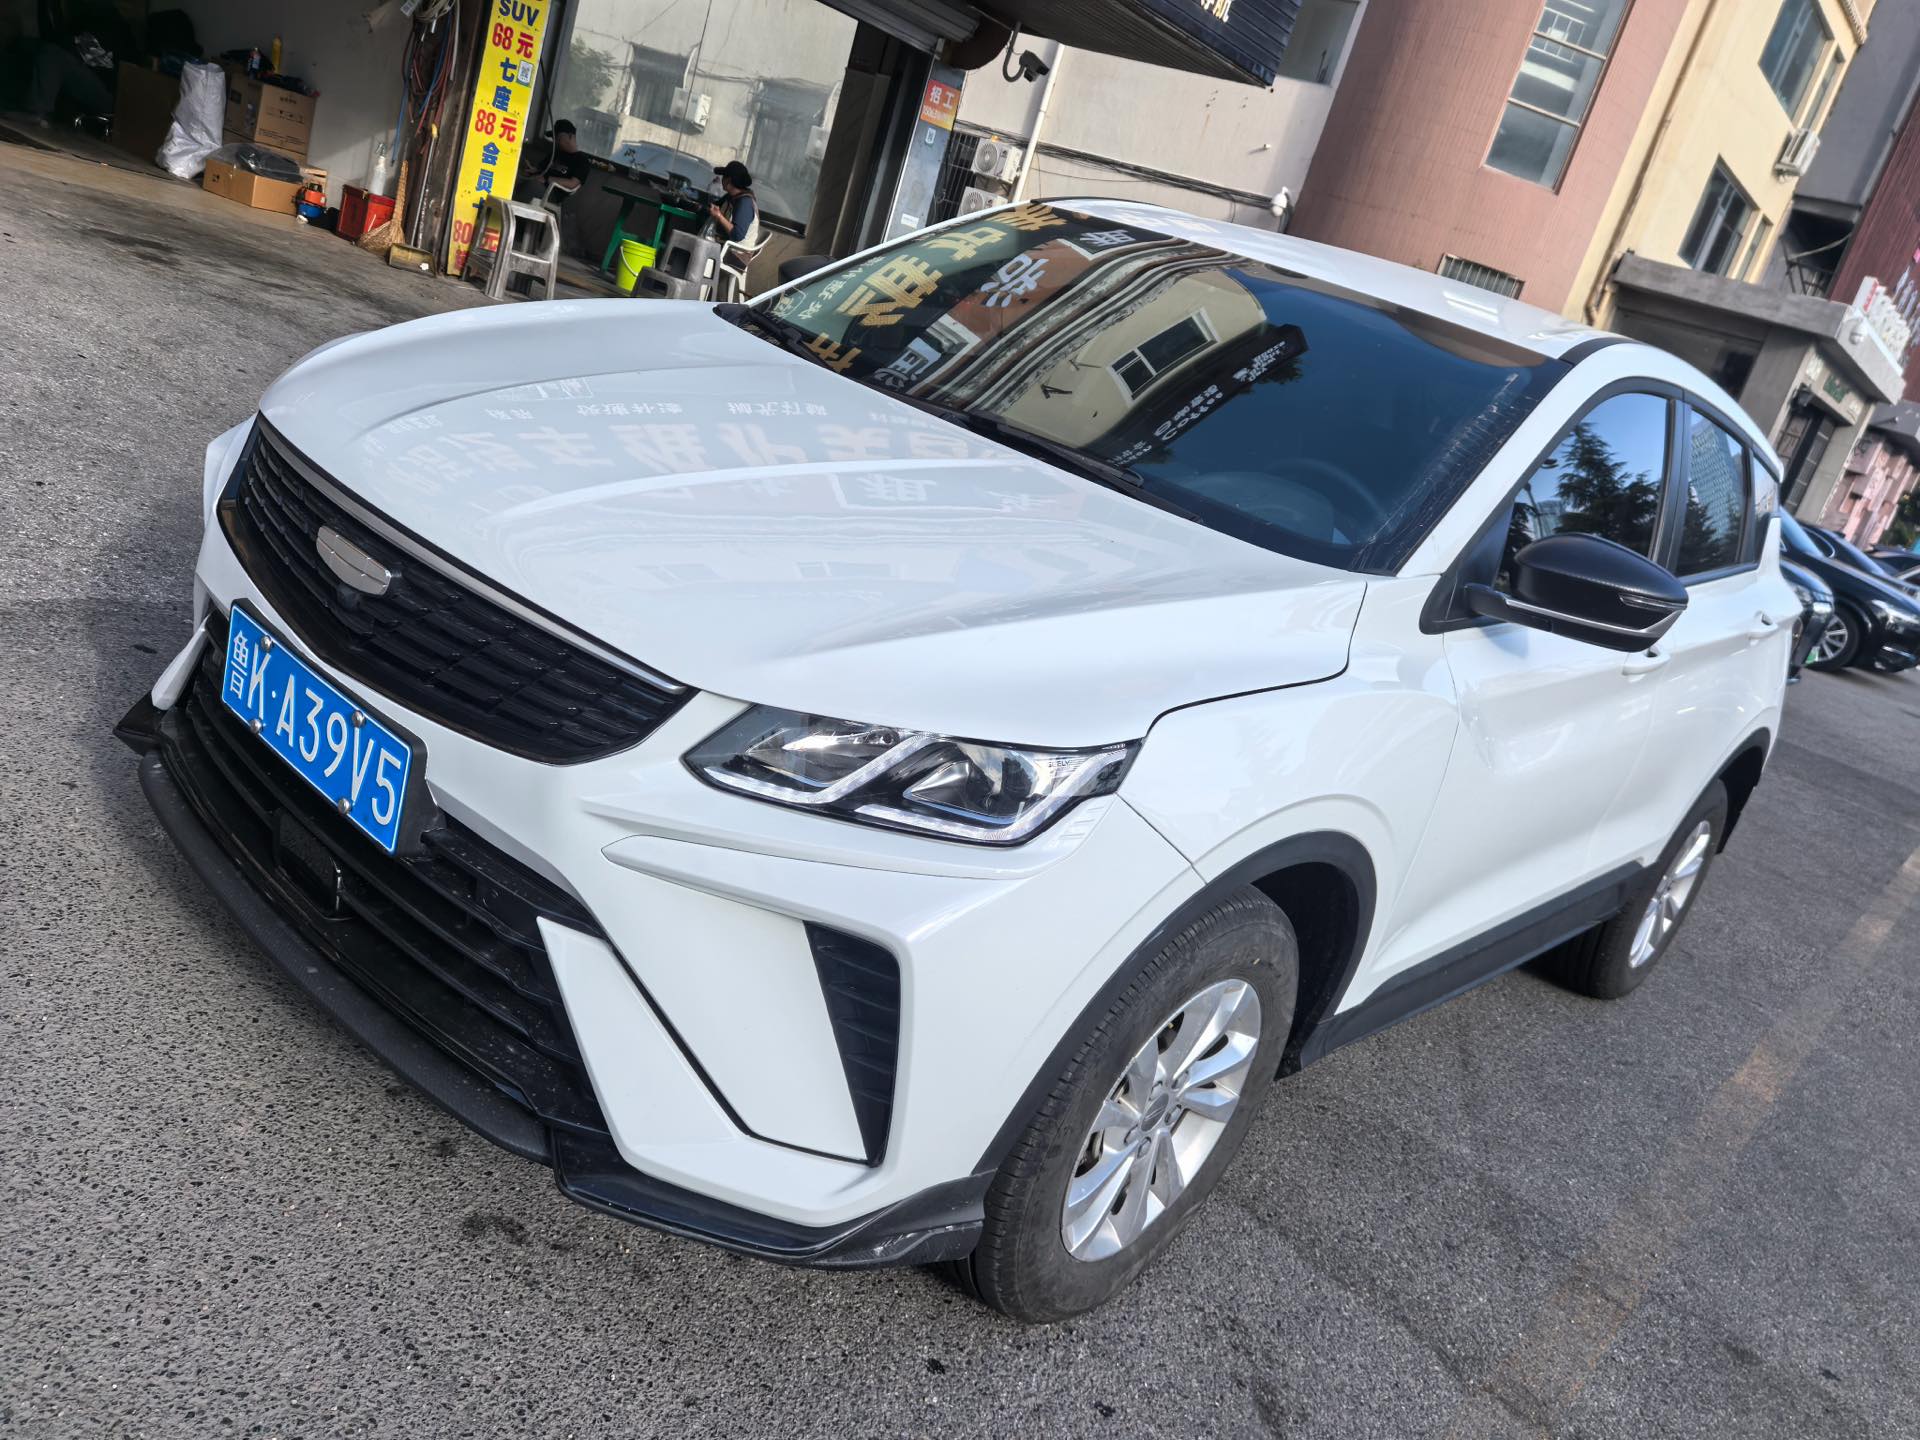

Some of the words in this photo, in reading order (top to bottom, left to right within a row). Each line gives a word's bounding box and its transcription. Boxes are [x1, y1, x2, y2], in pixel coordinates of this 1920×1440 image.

[500, 0, 540, 27] SUV
[492, 22, 534, 59] 68元
[492, 57, 518, 112] 七座
[930, 85, 955, 109] 招工
[475, 108, 517, 143] 88元
[472, 142, 500, 209] 会员
